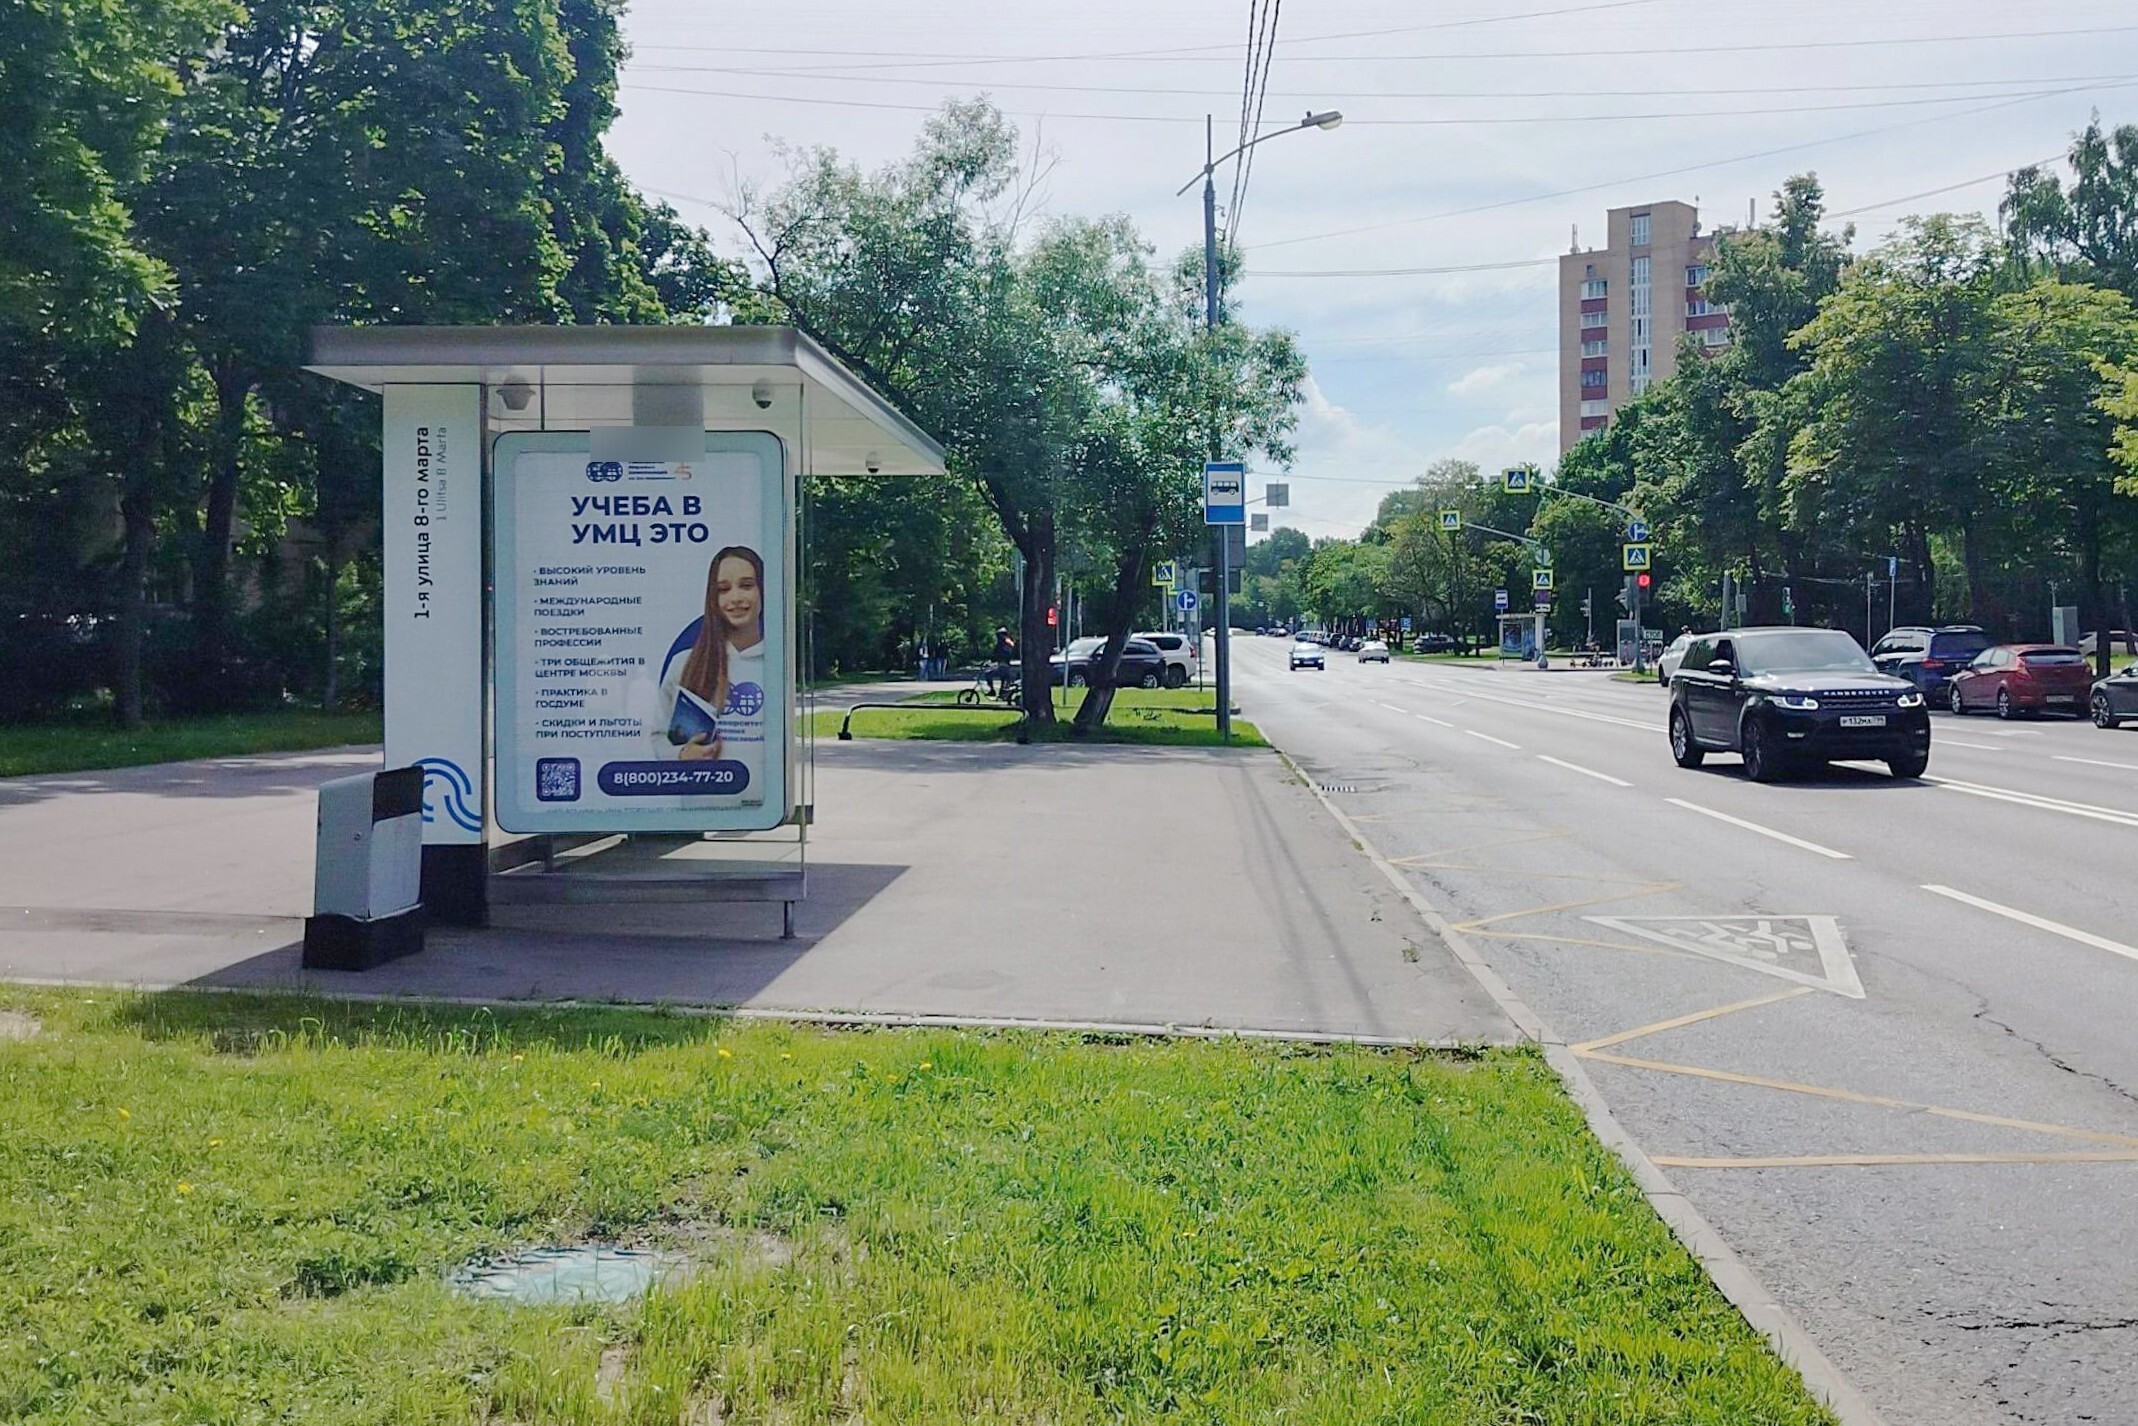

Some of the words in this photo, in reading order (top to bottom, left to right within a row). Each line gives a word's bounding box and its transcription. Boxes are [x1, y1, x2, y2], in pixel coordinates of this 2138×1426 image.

[417, 427, 432, 482] марта
[415, 488, 430, 526] 8-го
[571, 496, 673, 516] УЧЕБА
[682, 496, 702, 516] В
[572, 523, 641, 547] УМЦ
[649, 523, 709, 544] ЭТО
[418, 532, 433, 586] улица
[539, 565, 593, 575] ВЫСОКИЙ
[596, 566, 646, 574] УРОВЕНЬ
[533, 576, 578, 586] ЗНАНИЙ
[415, 591, 430, 619] 1-я
[540, 597, 642, 605] МЕЖДУНАРОДНЫЕ
[534, 608, 585, 617] ПОЕЗДКИ
[540, 627, 643, 636] ВОСТРЕБОВАННЫЕ
[534, 639, 602, 647] ПРОФЕССИИ
[541, 658, 562, 667] ТРИ
[638, 657, 646, 665] В
[535, 669, 577, 678] ЦЕНТРЕ
[580, 668, 627, 677] МОСКВЫ
[541, 688, 598, 696] ПРАКТИКА
[535, 700, 585, 709] ГОСДУМЕ
[542, 719, 586, 728] СКИДКИ
[588, 719, 596, 727] И
[600, 719, 642, 727] ЛЬГОТЫ
[561, 730, 641, 738] ПОСТУПЛЕНИИ
[613, 771, 734, 786] 8(800)234-77-20
